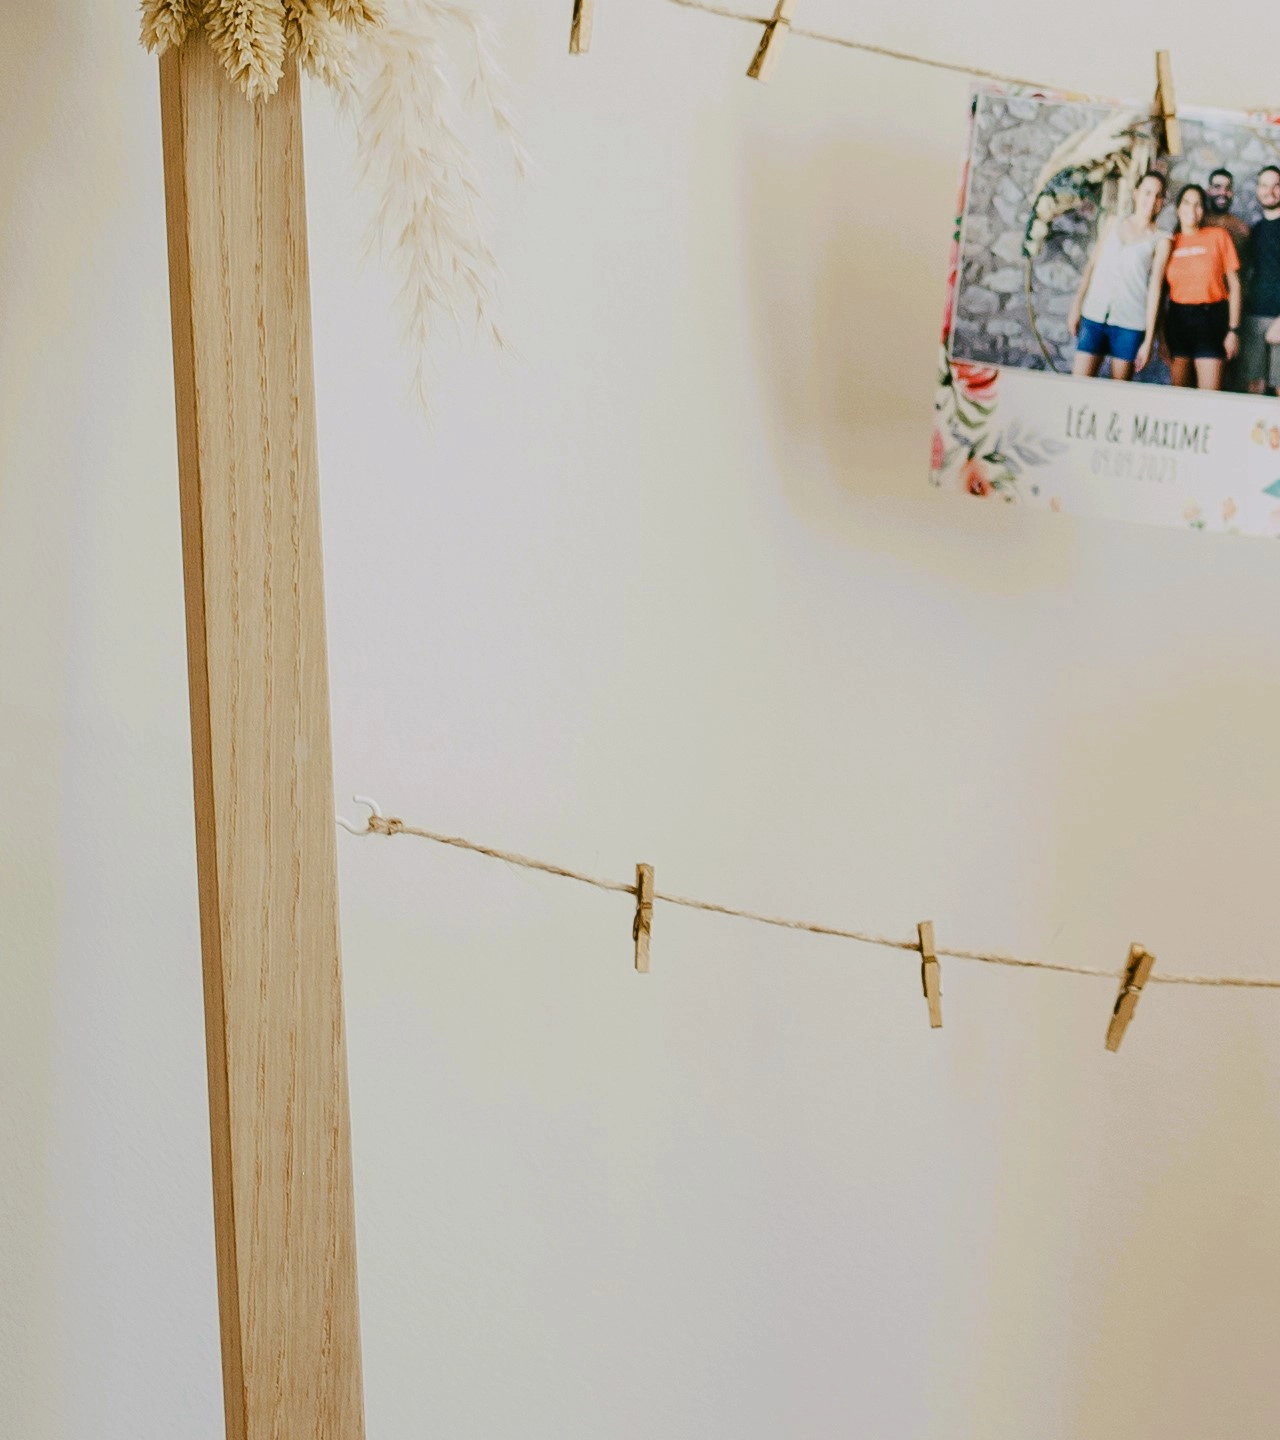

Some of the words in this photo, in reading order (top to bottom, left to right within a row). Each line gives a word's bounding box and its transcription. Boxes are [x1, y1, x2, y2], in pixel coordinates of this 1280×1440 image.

[1065, 403, 1097, 440] LÉA
[1105, 410, 1122, 444] &
[1131, 412, 1211, 454] MAXIME
